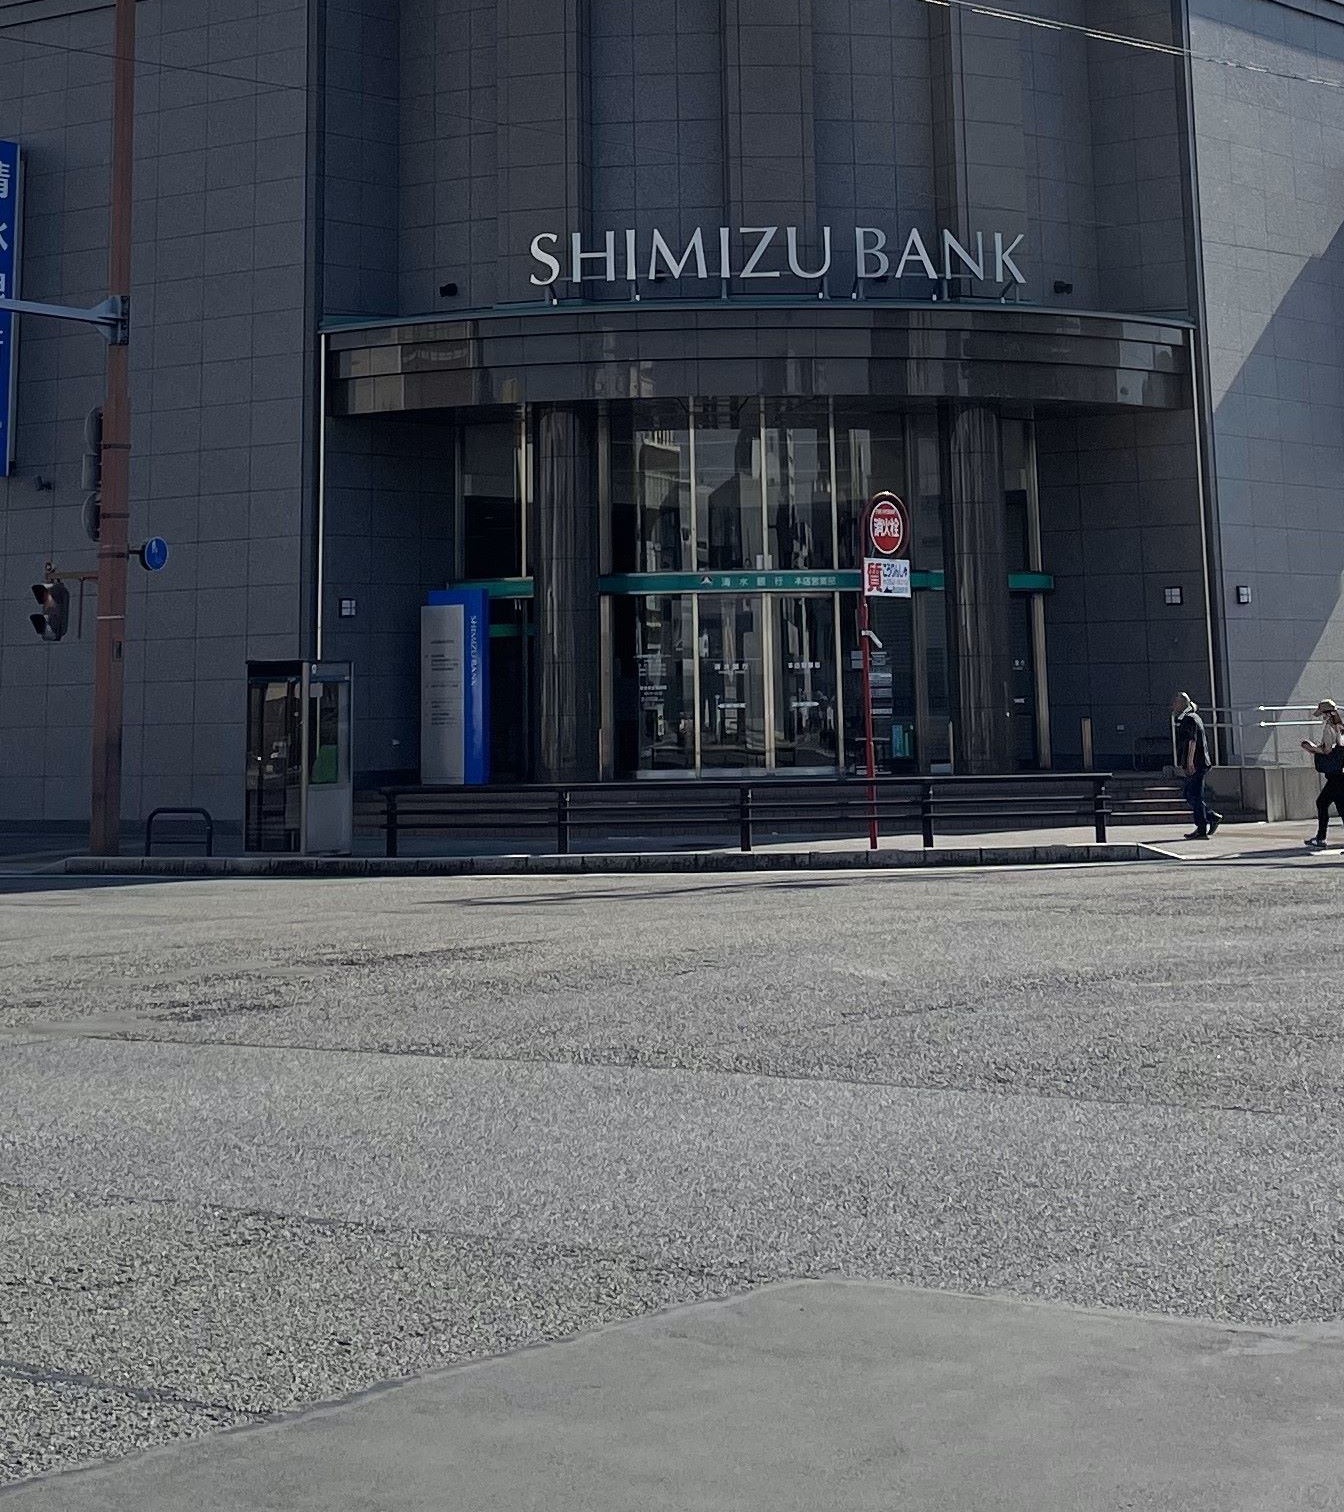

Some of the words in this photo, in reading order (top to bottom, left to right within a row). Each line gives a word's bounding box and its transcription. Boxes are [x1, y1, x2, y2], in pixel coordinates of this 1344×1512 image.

[529, 225, 833, 286] SHIMIZU
[856, 226, 1026, 284] BANK
[873, 517, 900, 537] 消火栓
[867, 562, 883, 593] 質
